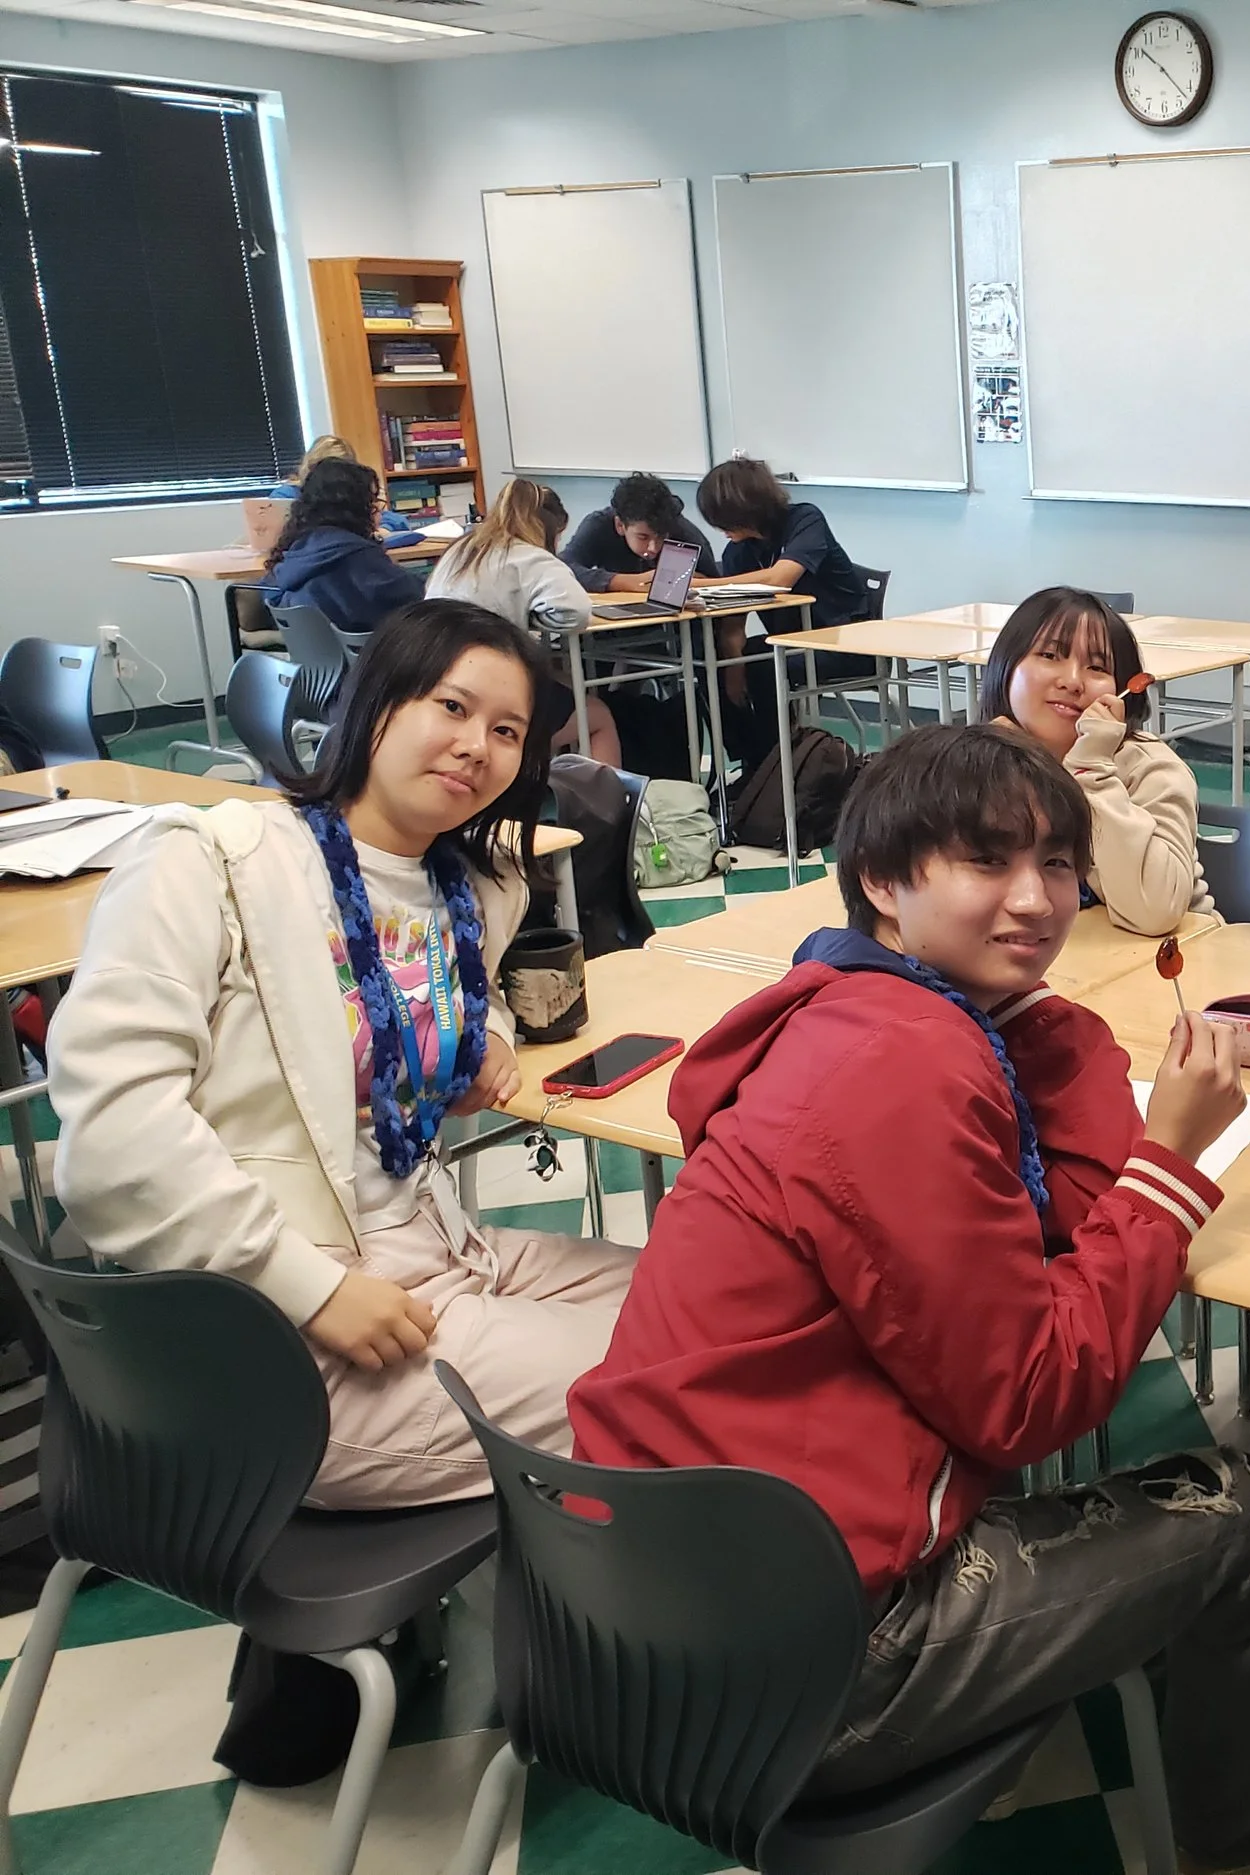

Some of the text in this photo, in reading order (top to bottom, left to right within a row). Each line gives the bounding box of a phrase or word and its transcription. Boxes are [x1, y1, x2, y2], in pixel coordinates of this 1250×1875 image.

[1144, 32, 1153, 45] 11
[1158, 26, 1169, 38] 12
[1175, 29, 1180, 42] 1
[1134, 47, 1143, 60] 10
[1186, 42, 1193, 54] 2
[1128, 66, 1134, 78] 9
[1186, 80, 1192, 92] 4
[1146, 97, 1152, 110] 7
[1161, 101, 1168, 113] 6
[1175, 95, 1182, 108] 5
[431, 949, 443, 985] TOKAI
[389, 977, 411, 1027] COLLEGE
[436, 986, 451, 1030] HAWAII
